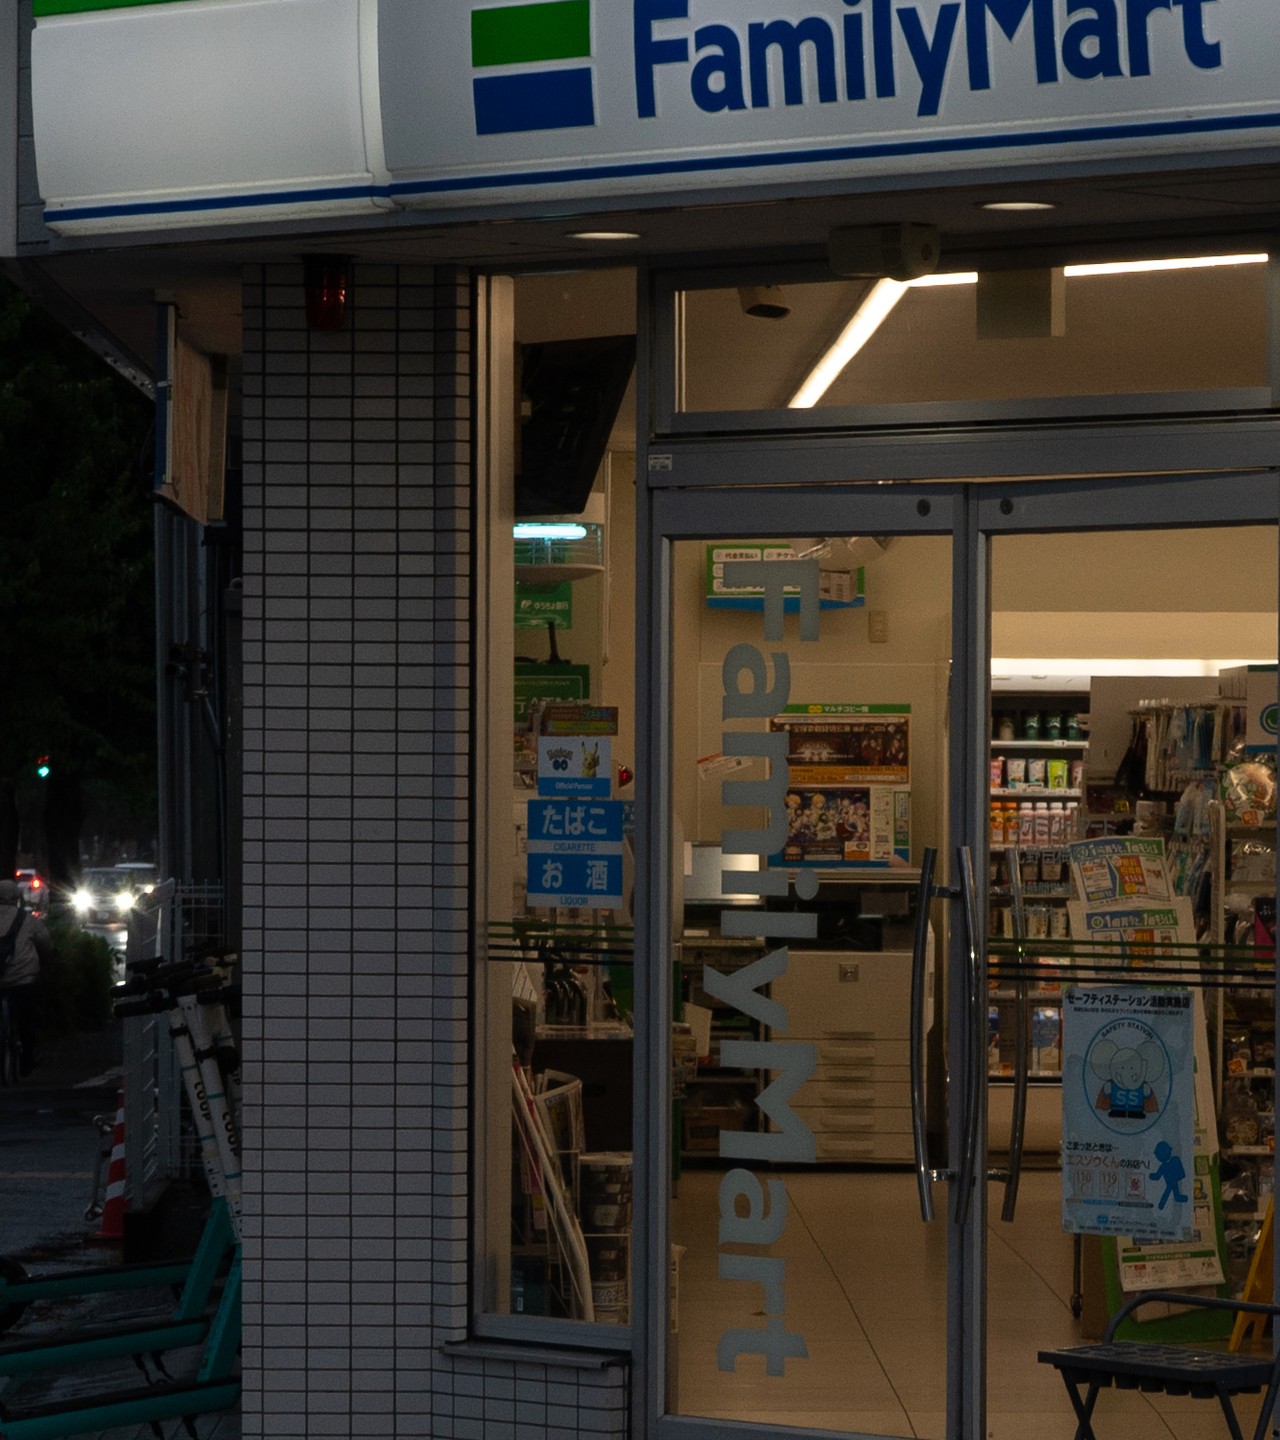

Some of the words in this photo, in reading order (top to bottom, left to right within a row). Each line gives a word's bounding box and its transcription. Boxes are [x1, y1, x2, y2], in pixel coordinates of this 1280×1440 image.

[542, 804, 608, 835] たばこ
[554, 843, 596, 852] CIGARETTE
[560, 896, 588, 906] LIQUOR
[703, 559, 820, 1377] FamilyMart
[1115, 1089, 1138, 1107] SS
